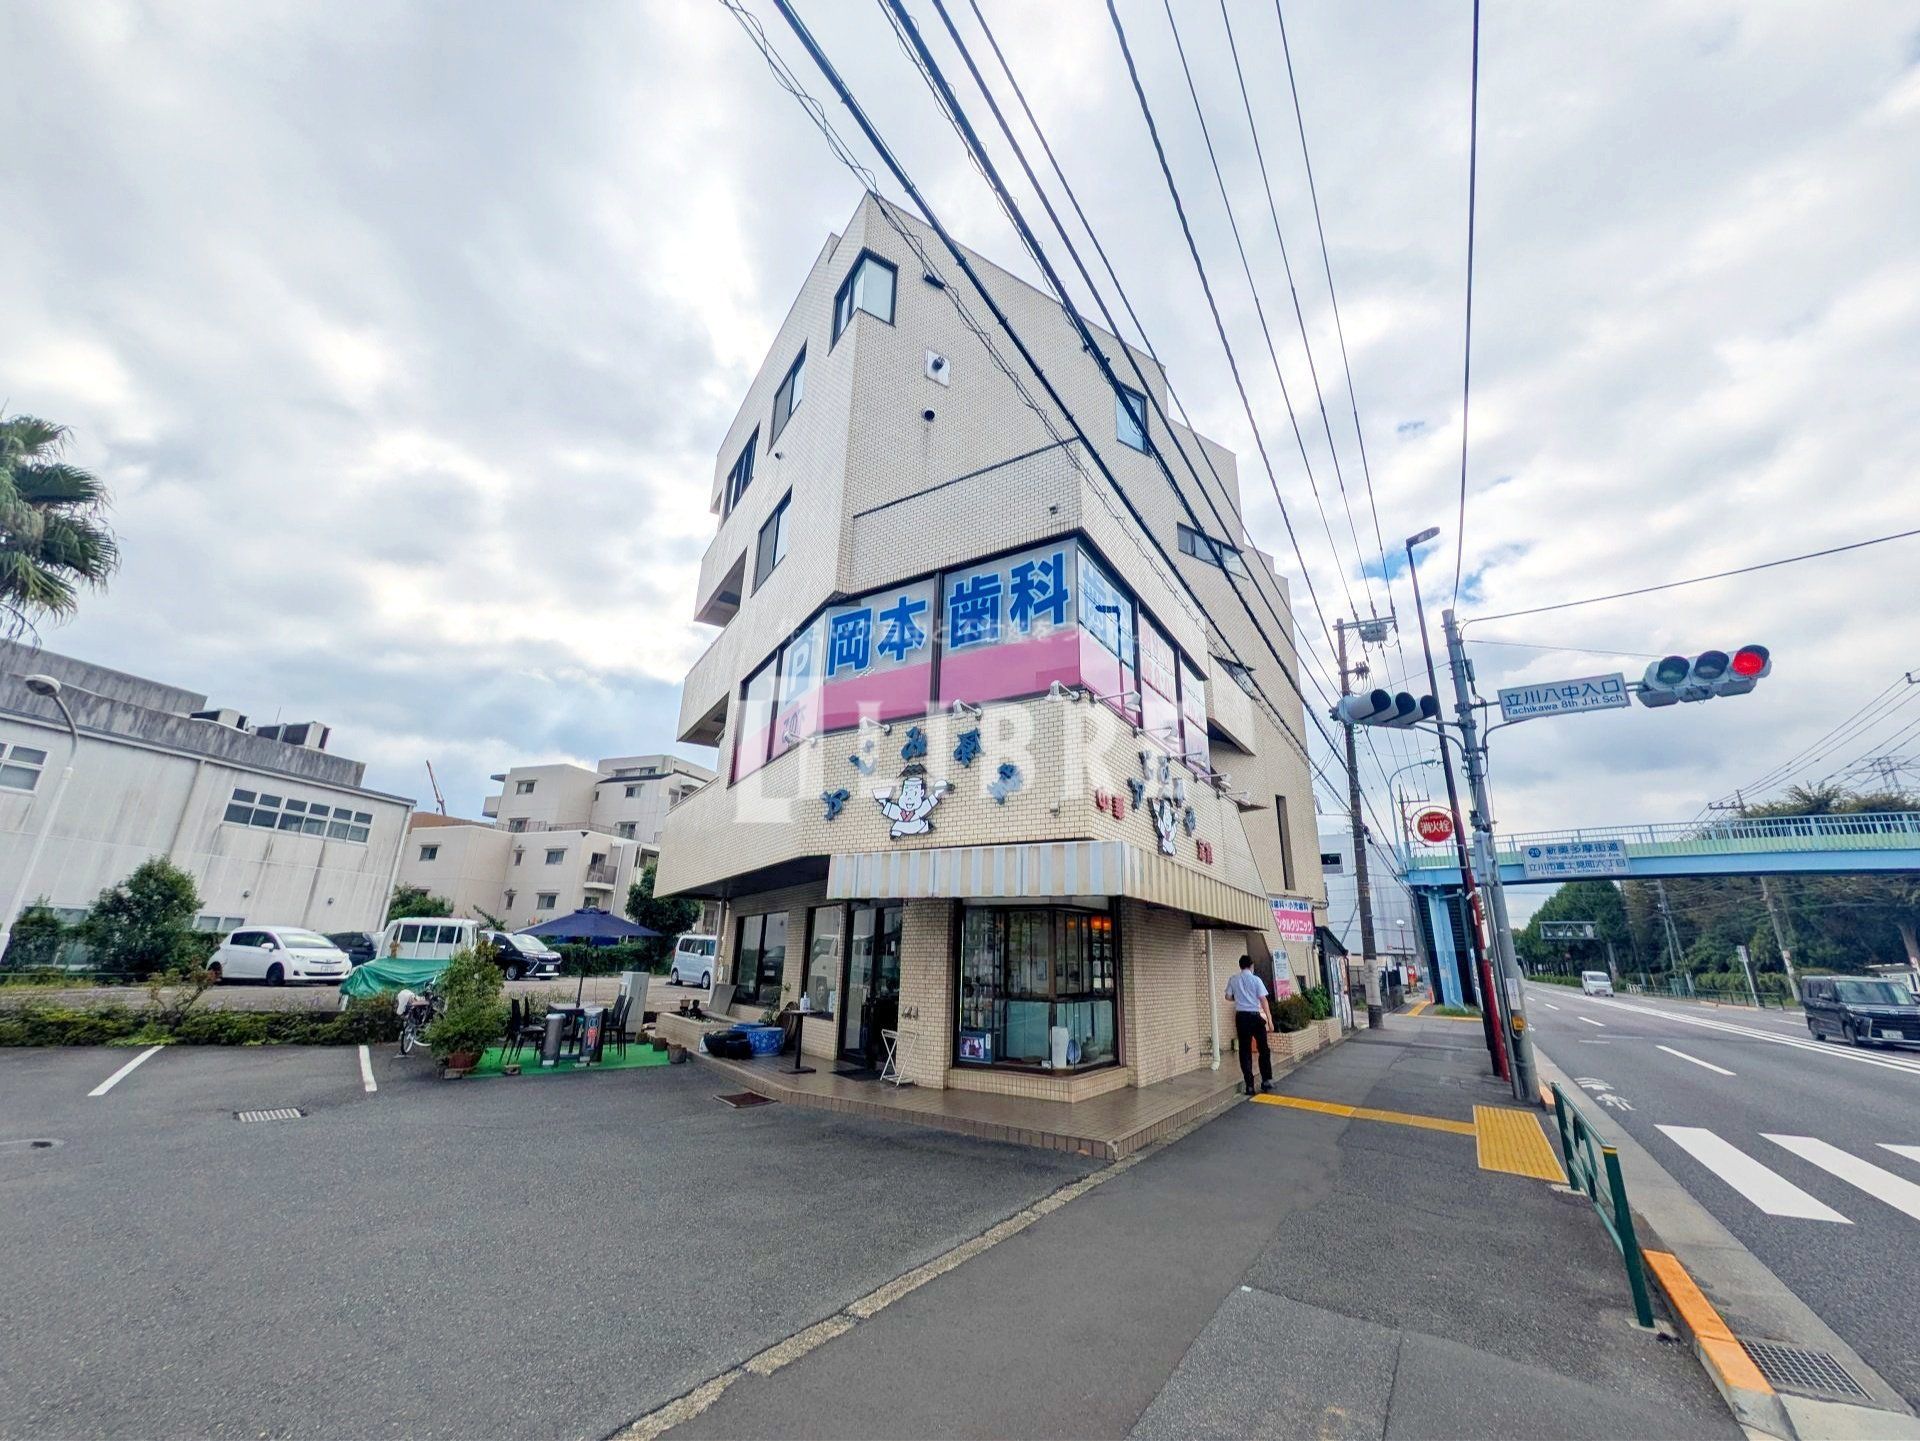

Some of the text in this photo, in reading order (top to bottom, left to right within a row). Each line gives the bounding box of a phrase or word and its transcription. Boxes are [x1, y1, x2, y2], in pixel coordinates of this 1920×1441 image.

[826, 551, 1070, 679] 岡本歯科
[1504, 679, 1620, 707] 立川八中入口
[1506, 704, 1558, 716] Tachikawa
[1561, 699, 1578, 708] 8th
[1420, 819, 1451, 834] 消火栓
